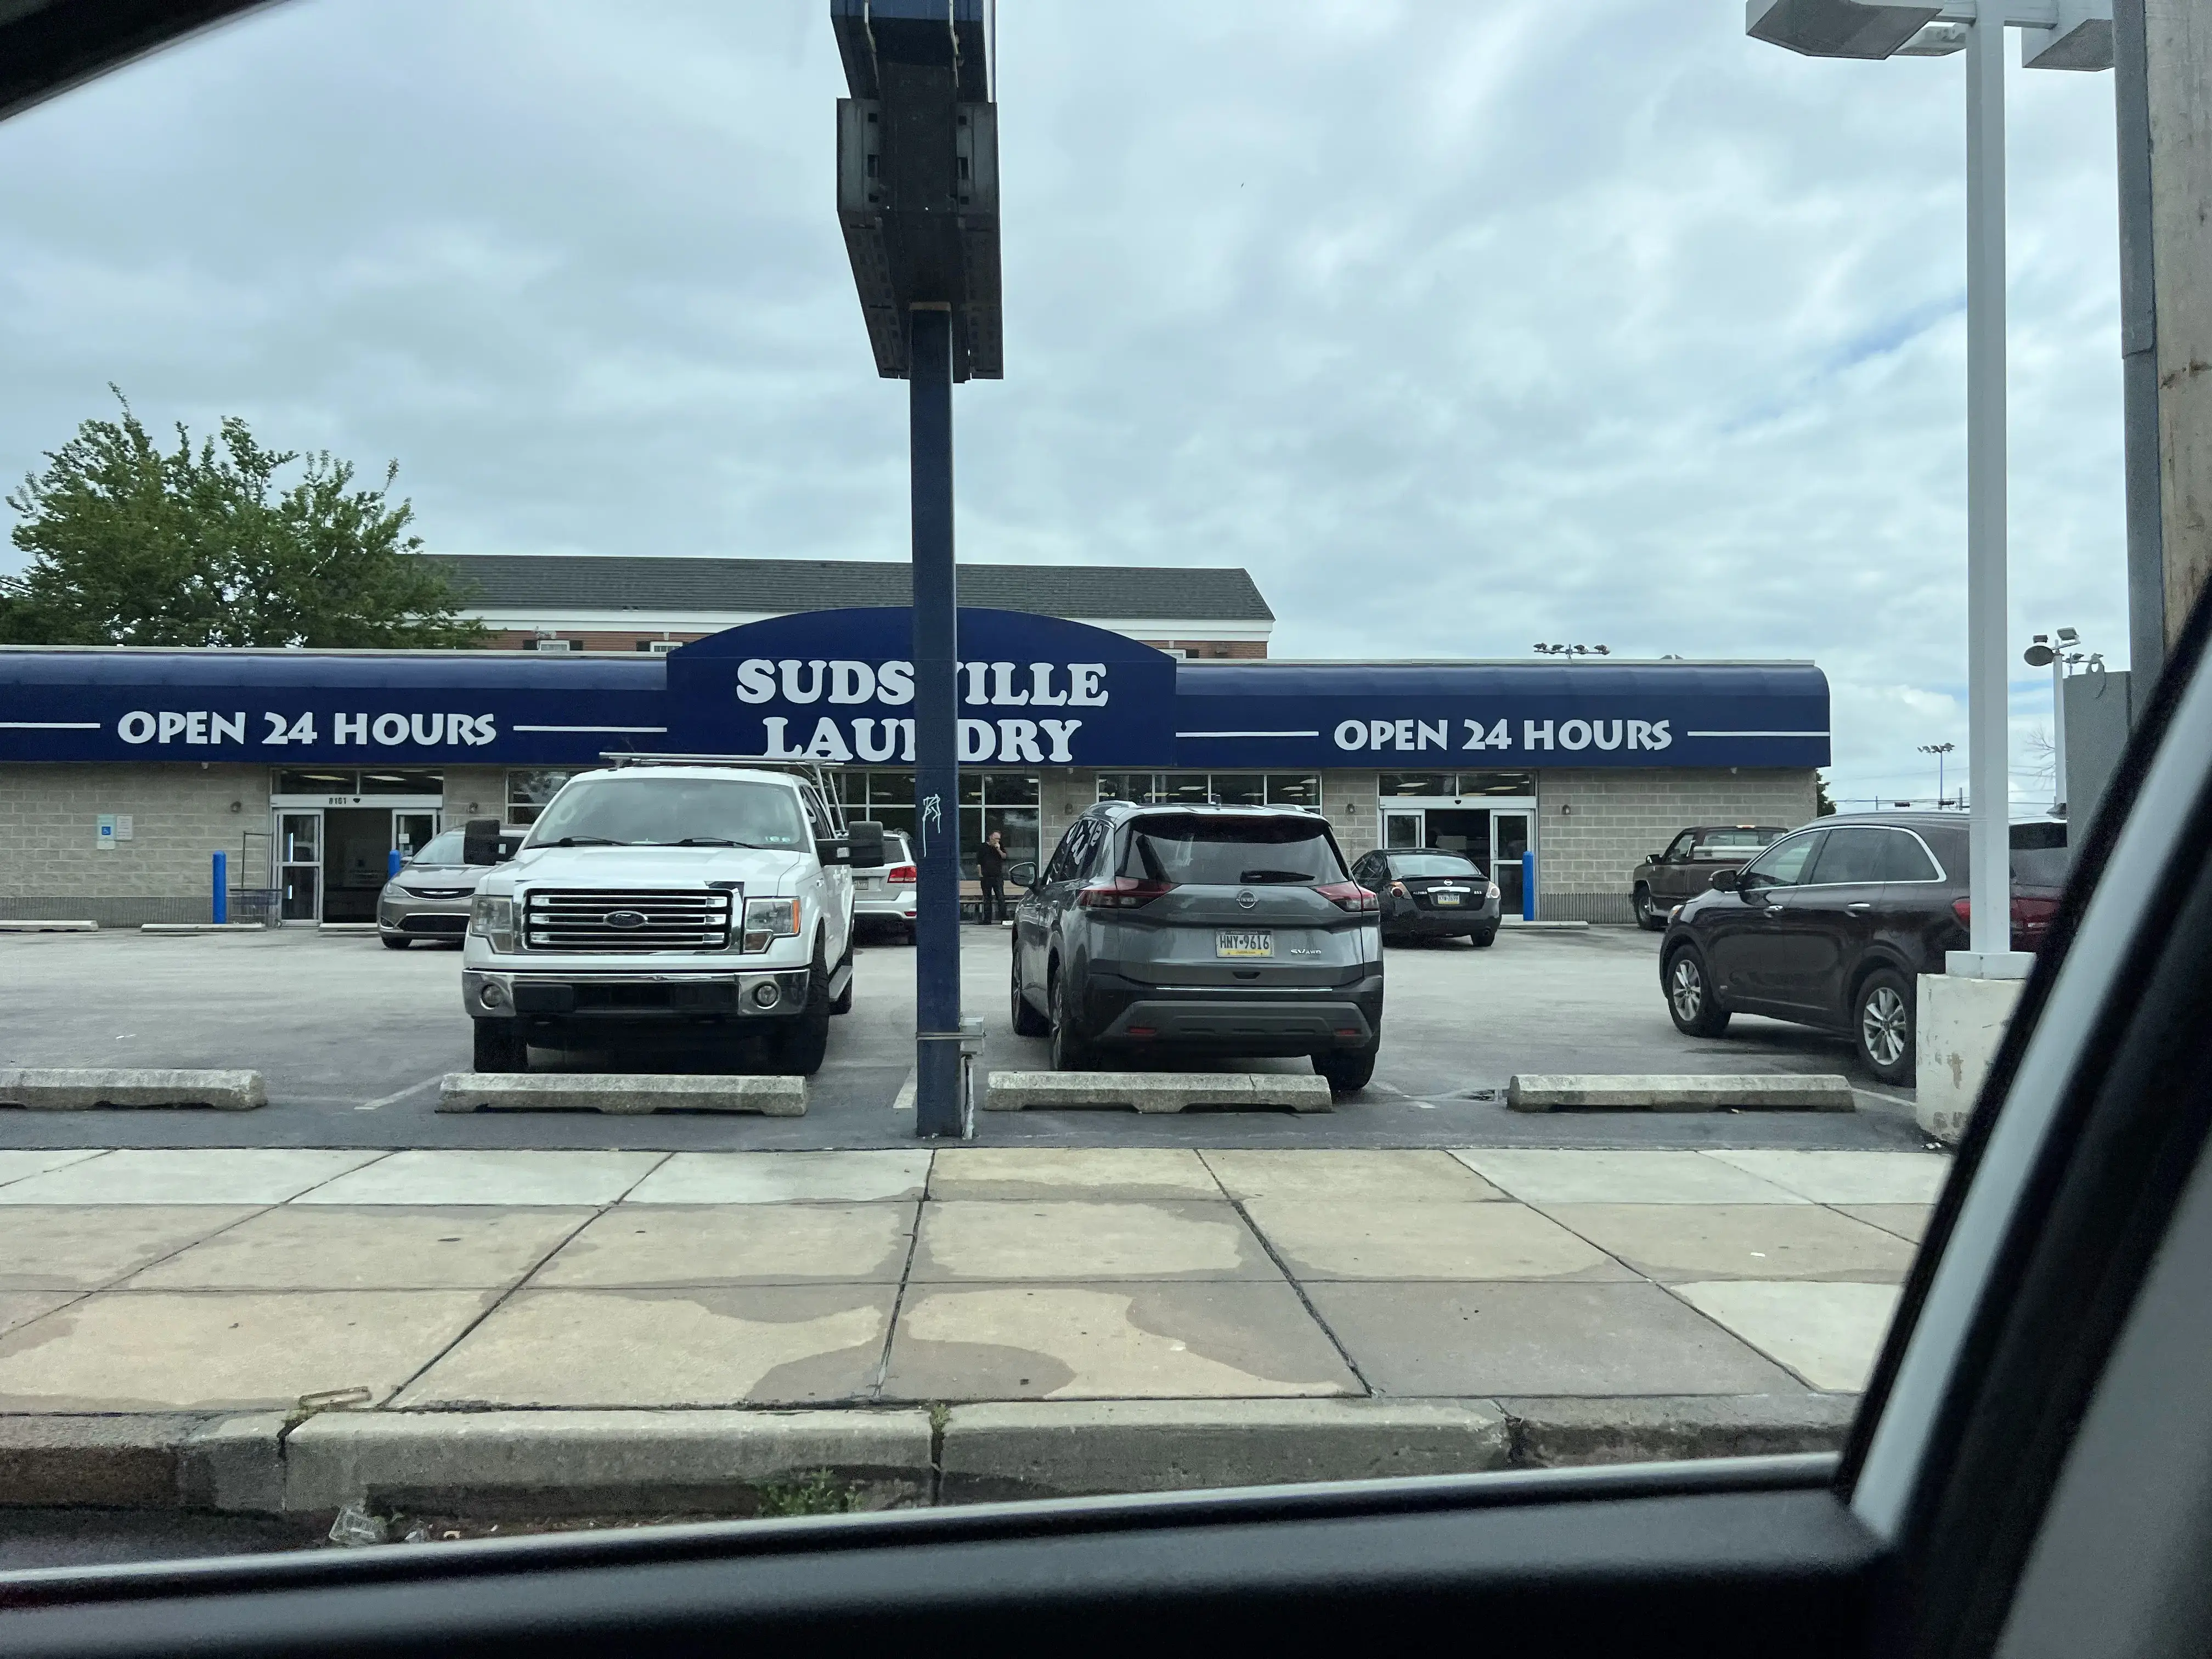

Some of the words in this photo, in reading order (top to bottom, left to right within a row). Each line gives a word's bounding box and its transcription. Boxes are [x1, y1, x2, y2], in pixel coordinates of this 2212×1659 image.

[736, 659, 1109, 707] SUDSILLE
[118, 711, 245, 744] OPEN
[262, 712, 318, 745] 24
[335, 713, 496, 746] HOURS
[1334, 719, 1448, 751] OPEN
[1462, 718, 1512, 750] 24
[1523, 719, 1672, 751] HOURS
